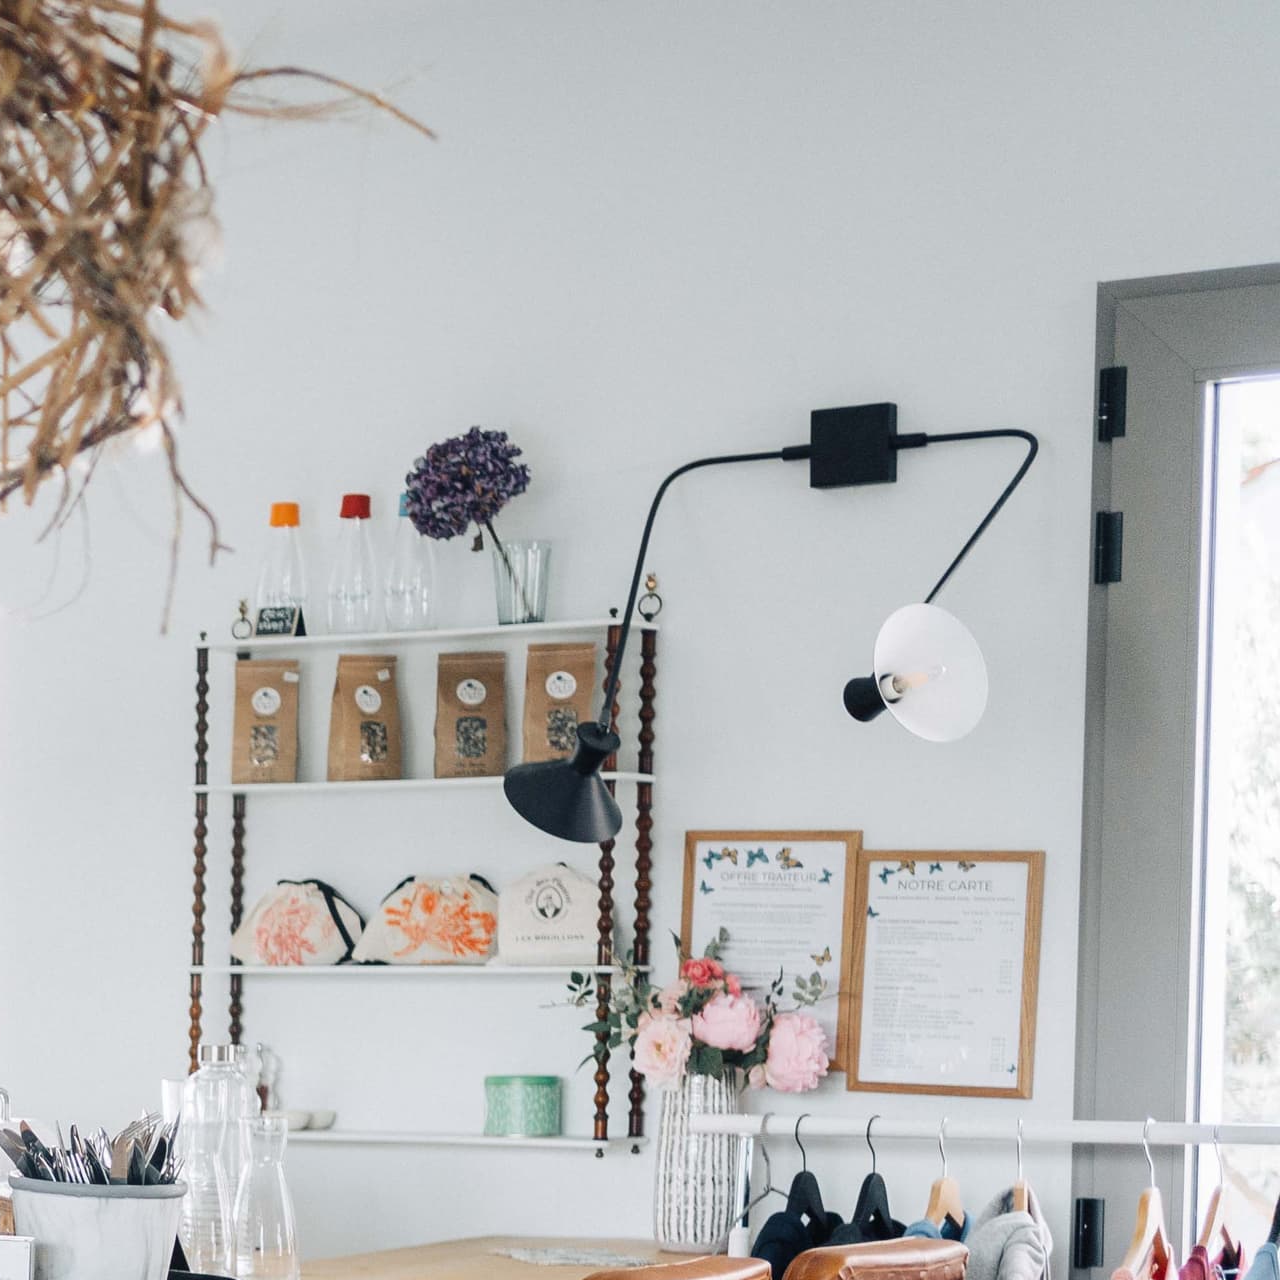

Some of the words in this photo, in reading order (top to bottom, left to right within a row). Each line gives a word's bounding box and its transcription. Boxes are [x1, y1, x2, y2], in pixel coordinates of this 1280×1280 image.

[720, 871, 758, 882] OFFRE
[762, 871, 817, 882] TRAITEUR
[897, 879, 945, 891] NOTRE
[948, 880, 993, 892] CARTE
